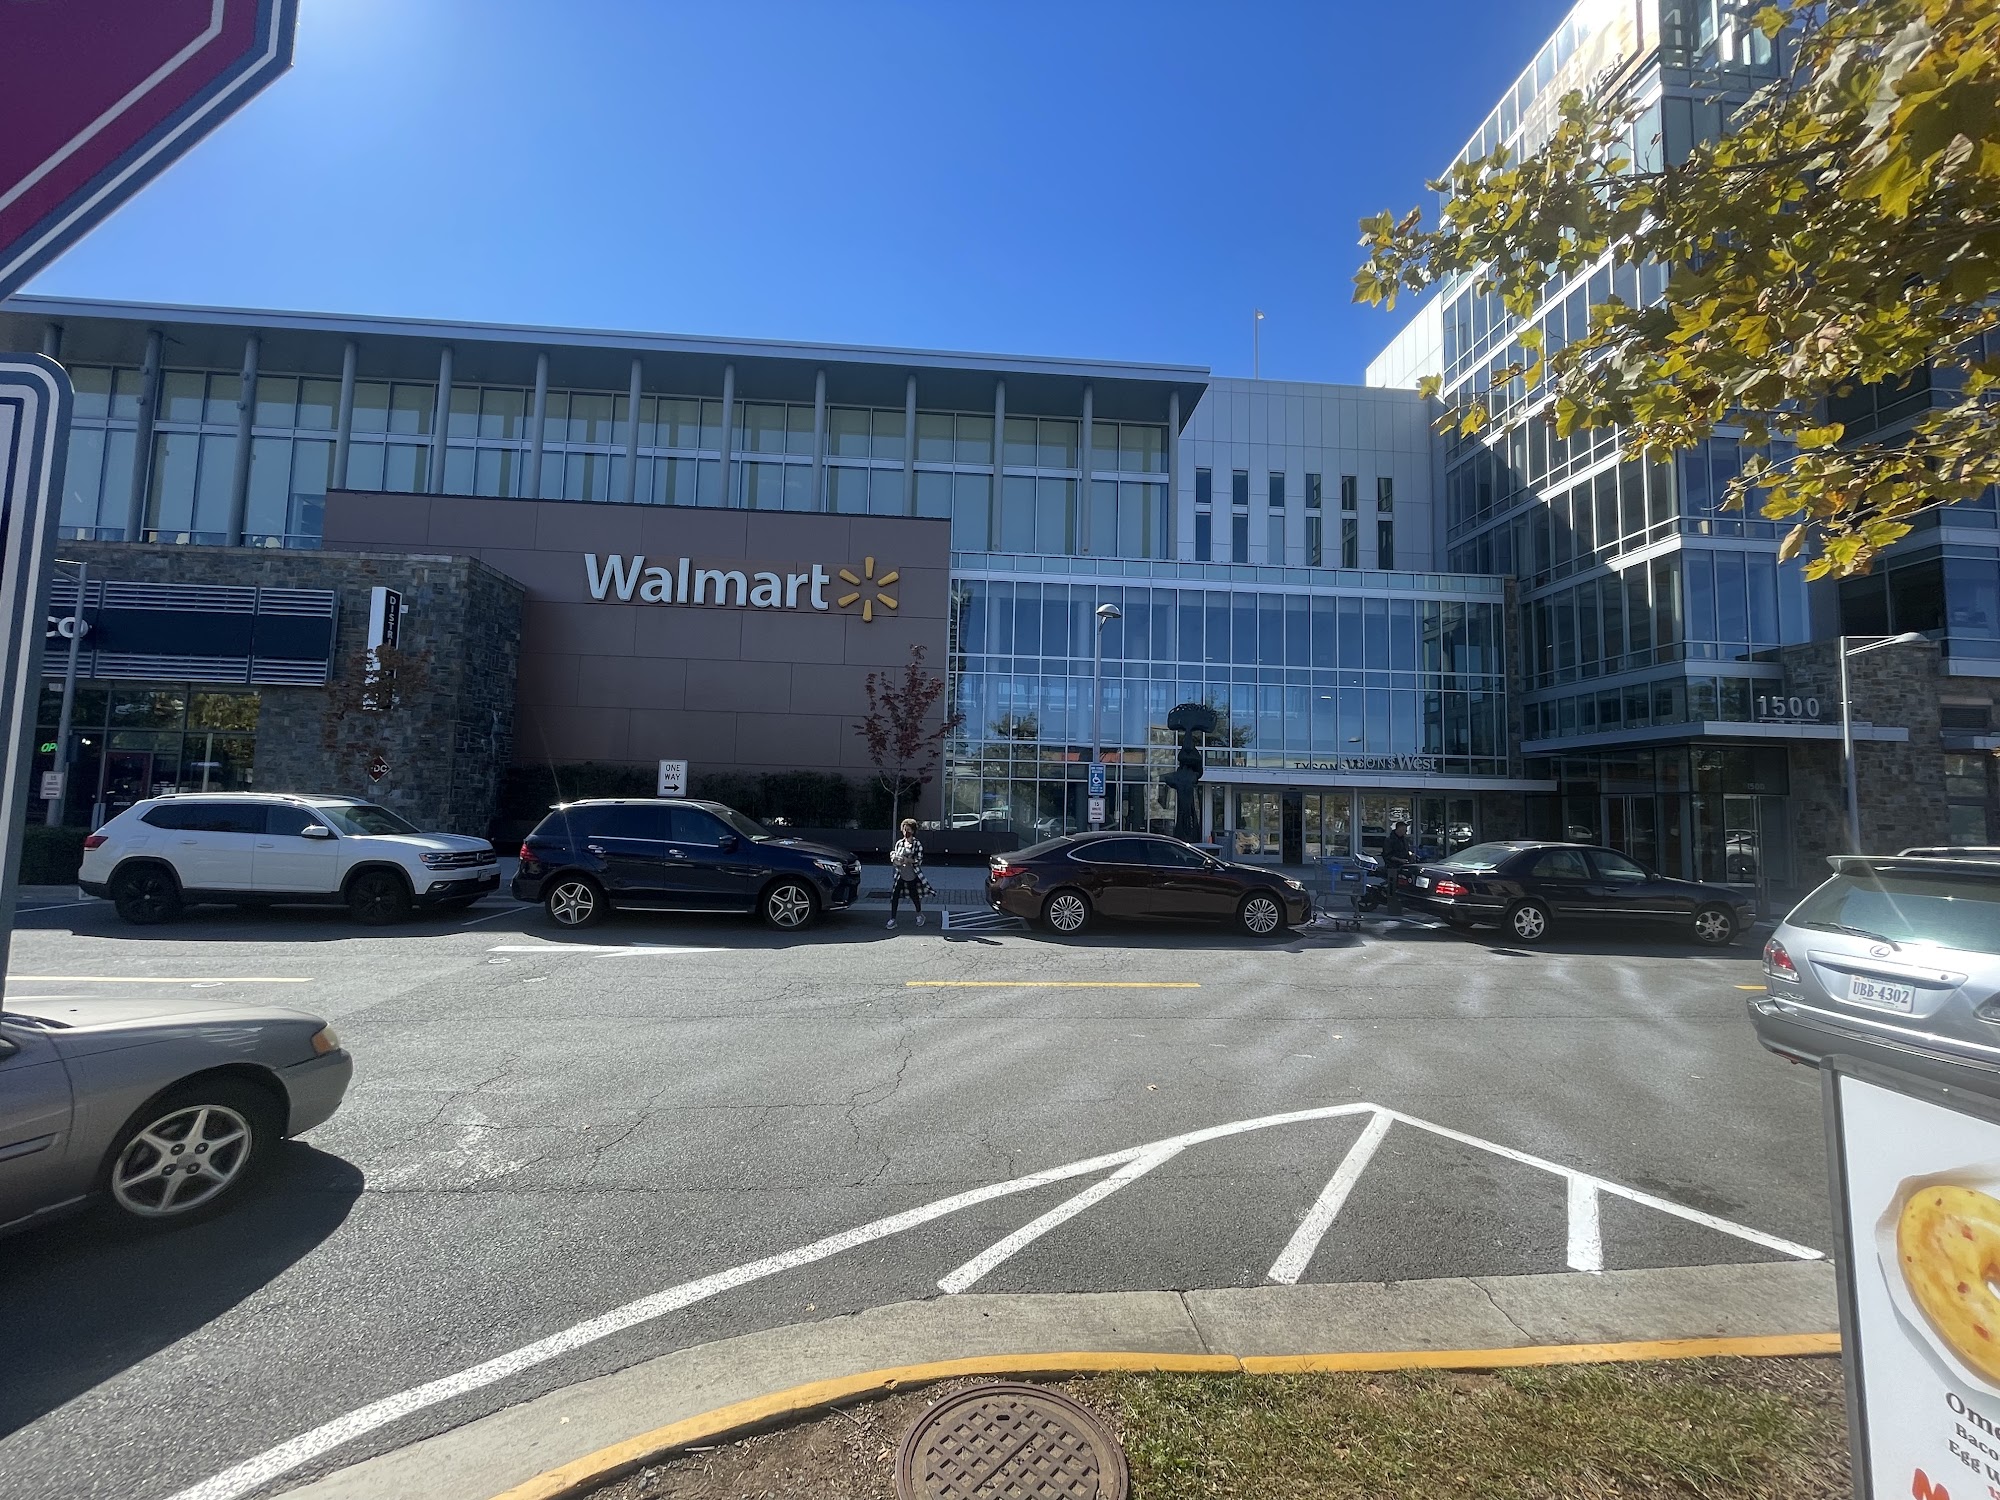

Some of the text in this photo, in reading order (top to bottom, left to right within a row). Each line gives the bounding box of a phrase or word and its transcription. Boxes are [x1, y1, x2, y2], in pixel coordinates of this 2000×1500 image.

[584, 553, 829, 610] Walmart
[1756, 695, 1819, 717] 1500
[665, 773, 681, 781] WAY
[1853, 981, 1909, 1003] UBB-4302
[1948, 1439, 1981, 1474] Egg
